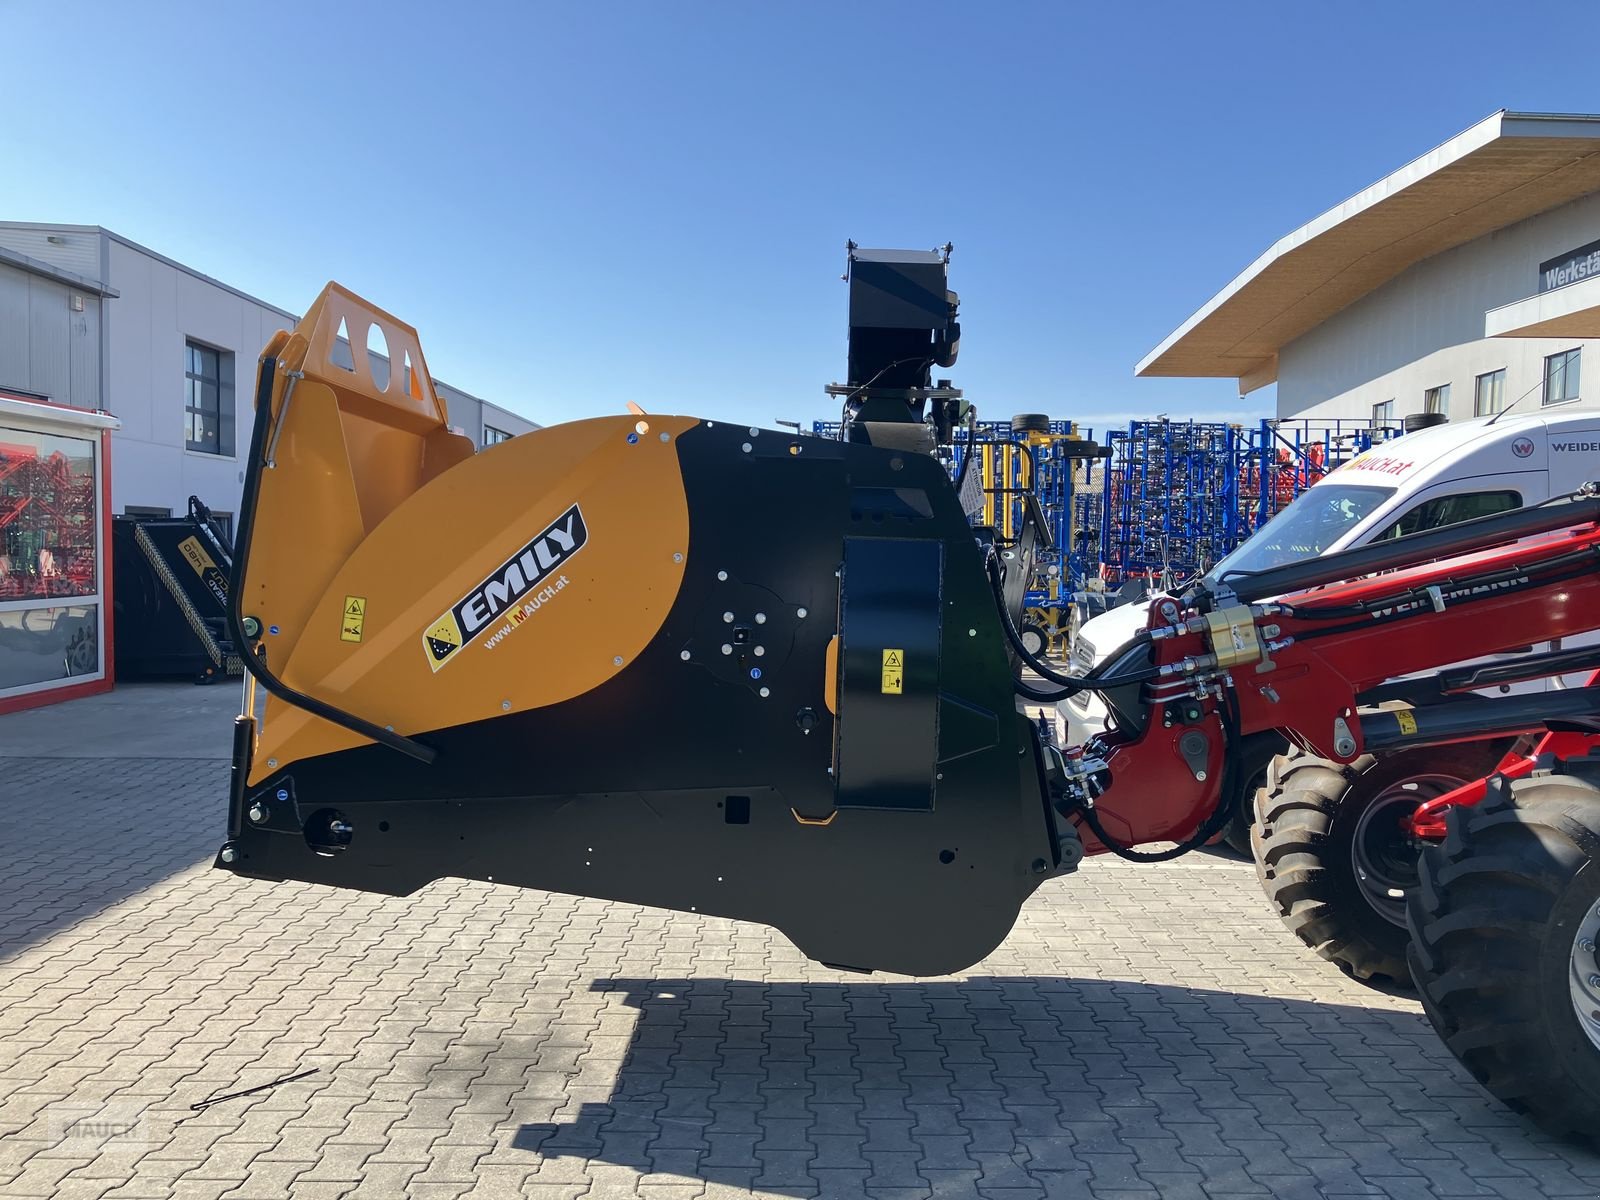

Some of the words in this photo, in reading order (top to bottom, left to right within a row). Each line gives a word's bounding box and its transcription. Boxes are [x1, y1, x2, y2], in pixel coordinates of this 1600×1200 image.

[1552, 442, 1600, 452] WEIDE
[460, 514, 576, 633] EMILY
[484, 574, 570, 650] www.MAUCH.at
